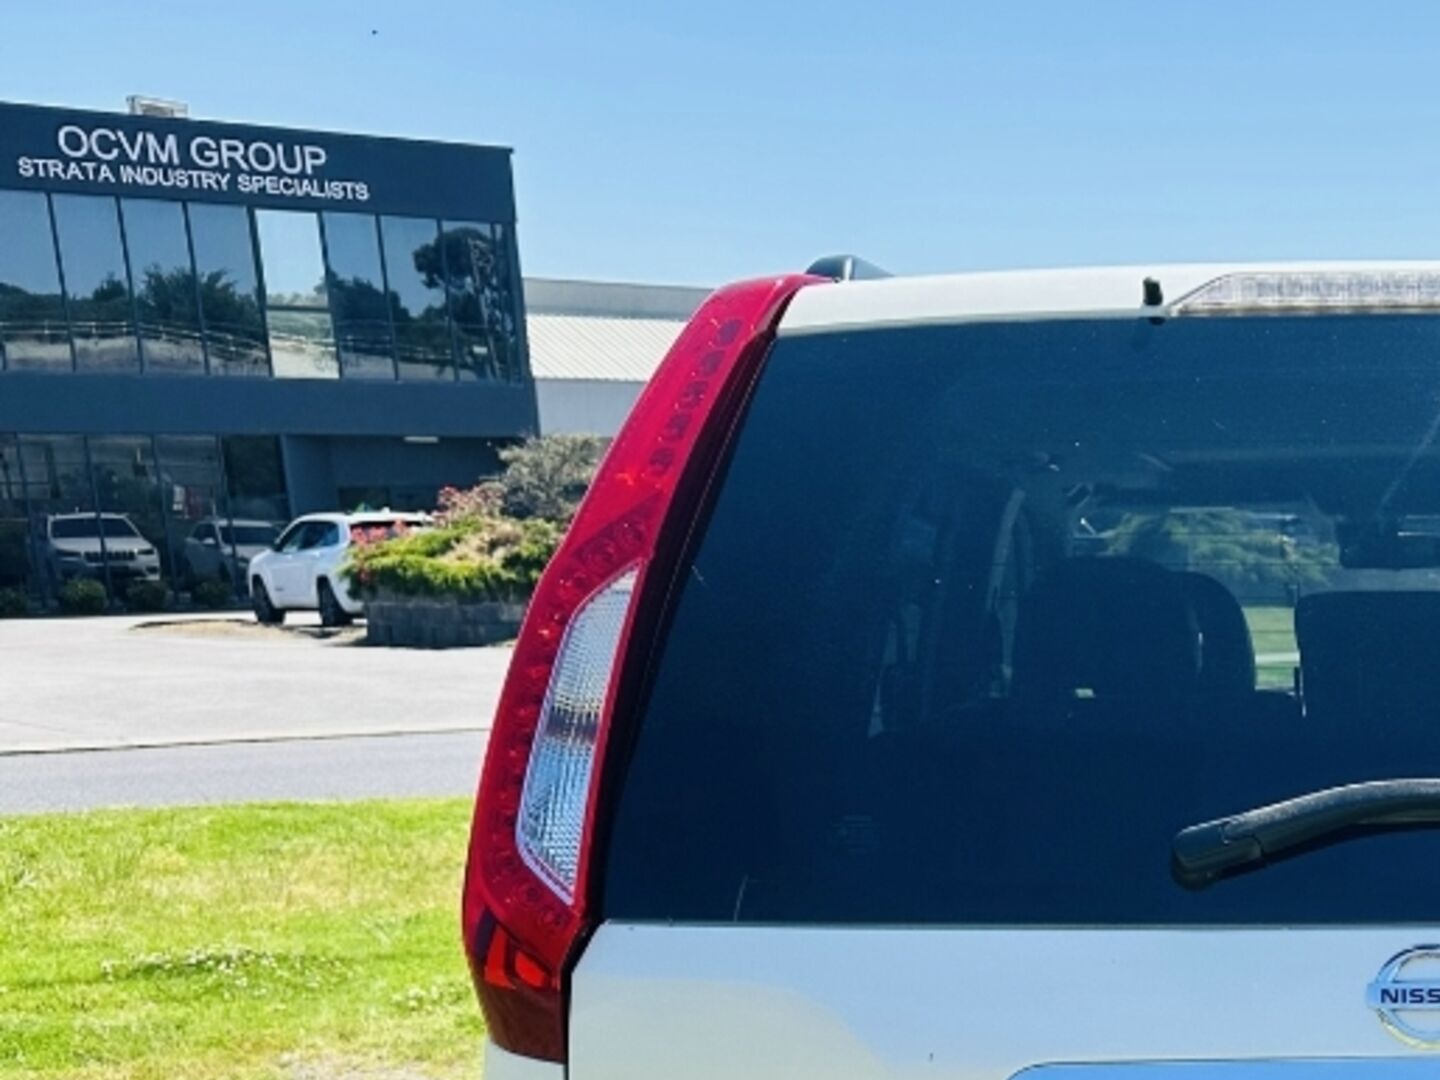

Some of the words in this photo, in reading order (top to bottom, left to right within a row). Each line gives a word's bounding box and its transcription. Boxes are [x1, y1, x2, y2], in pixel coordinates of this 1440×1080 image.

[57, 125, 180, 165] OCVM
[189, 136, 327, 175] GROUP
[18, 156, 114, 183] STRATA
[120, 164, 231, 191] INDUSTRY
[237, 173, 370, 201] SPECIALISTS
